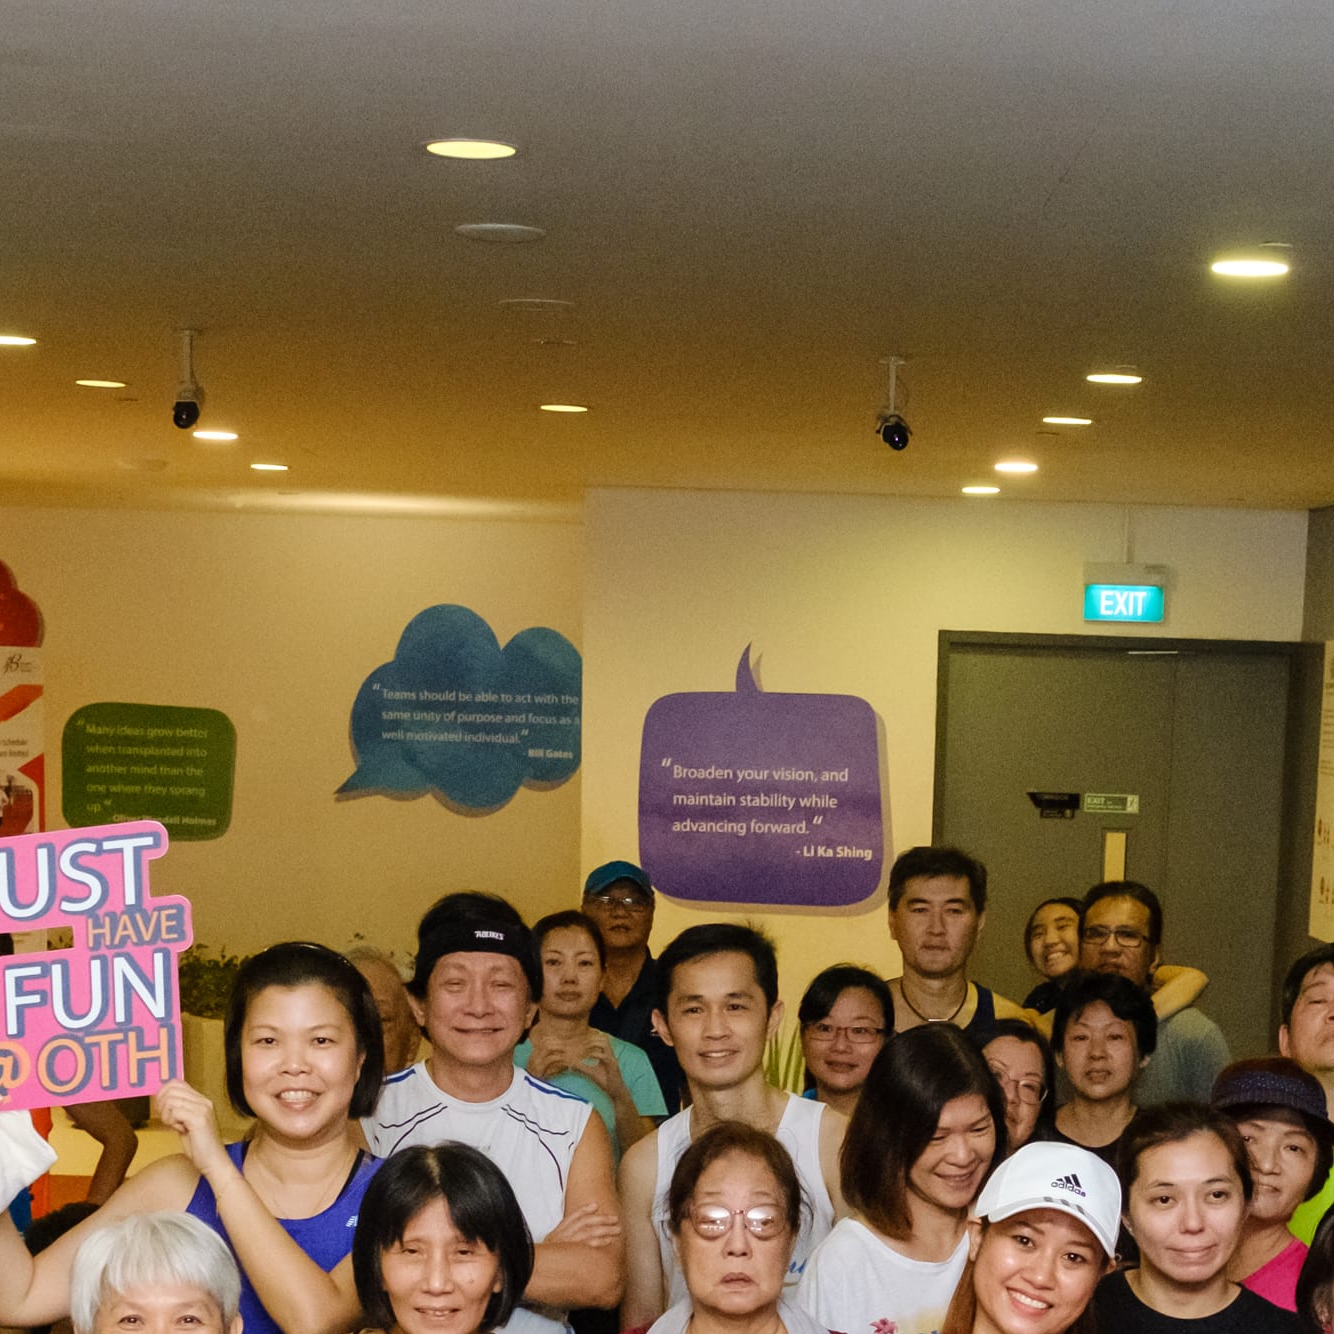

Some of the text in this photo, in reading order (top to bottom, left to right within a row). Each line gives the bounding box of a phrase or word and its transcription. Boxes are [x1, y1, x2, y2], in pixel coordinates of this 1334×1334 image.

[1100, 590, 1147, 616] EXIT
[419, 690, 456, 702] should
[458, 691, 472, 702] be
[475, 691, 498, 702] able
[501, 693, 512, 703] to
[515, 694, 532, 704] act
[534, 693, 558, 704] with
[561, 695, 579, 705] the
[382, 711, 411, 720] same
[413, 710, 440, 724] unity
[443, 711, 456, 721] of
[457, 713, 503, 725] purpose
[505, 712, 525, 723] and
[528, 713, 556, 724] focus
[559, 716, 571, 724] as
[117, 726, 144, 736] ideas
[147, 727, 173, 739] grow
[176, 727, 208, 739] better
[382, 730, 404, 740] well
[406, 730, 461, 742] motivated
[86, 745, 208, 758] when transplanted into
[528, 749, 573, 759] Bill Gates
[86, 763, 204, 776] another mind than the
[736, 769, 768, 783] your
[772, 768, 818, 782] vision,
[821, 768, 849, 782] and
[672, 793, 838, 810] maintain stability while
[672, 818, 747, 836] advancing
[803, 846, 872, 860] Li Ka Shing
[87, 907, 181, 948] HAVE
[4, 950, 169, 1037] FUN
[37, 1026, 171, 1094] OTH
[1050, 1180, 1086, 1197] adidas
